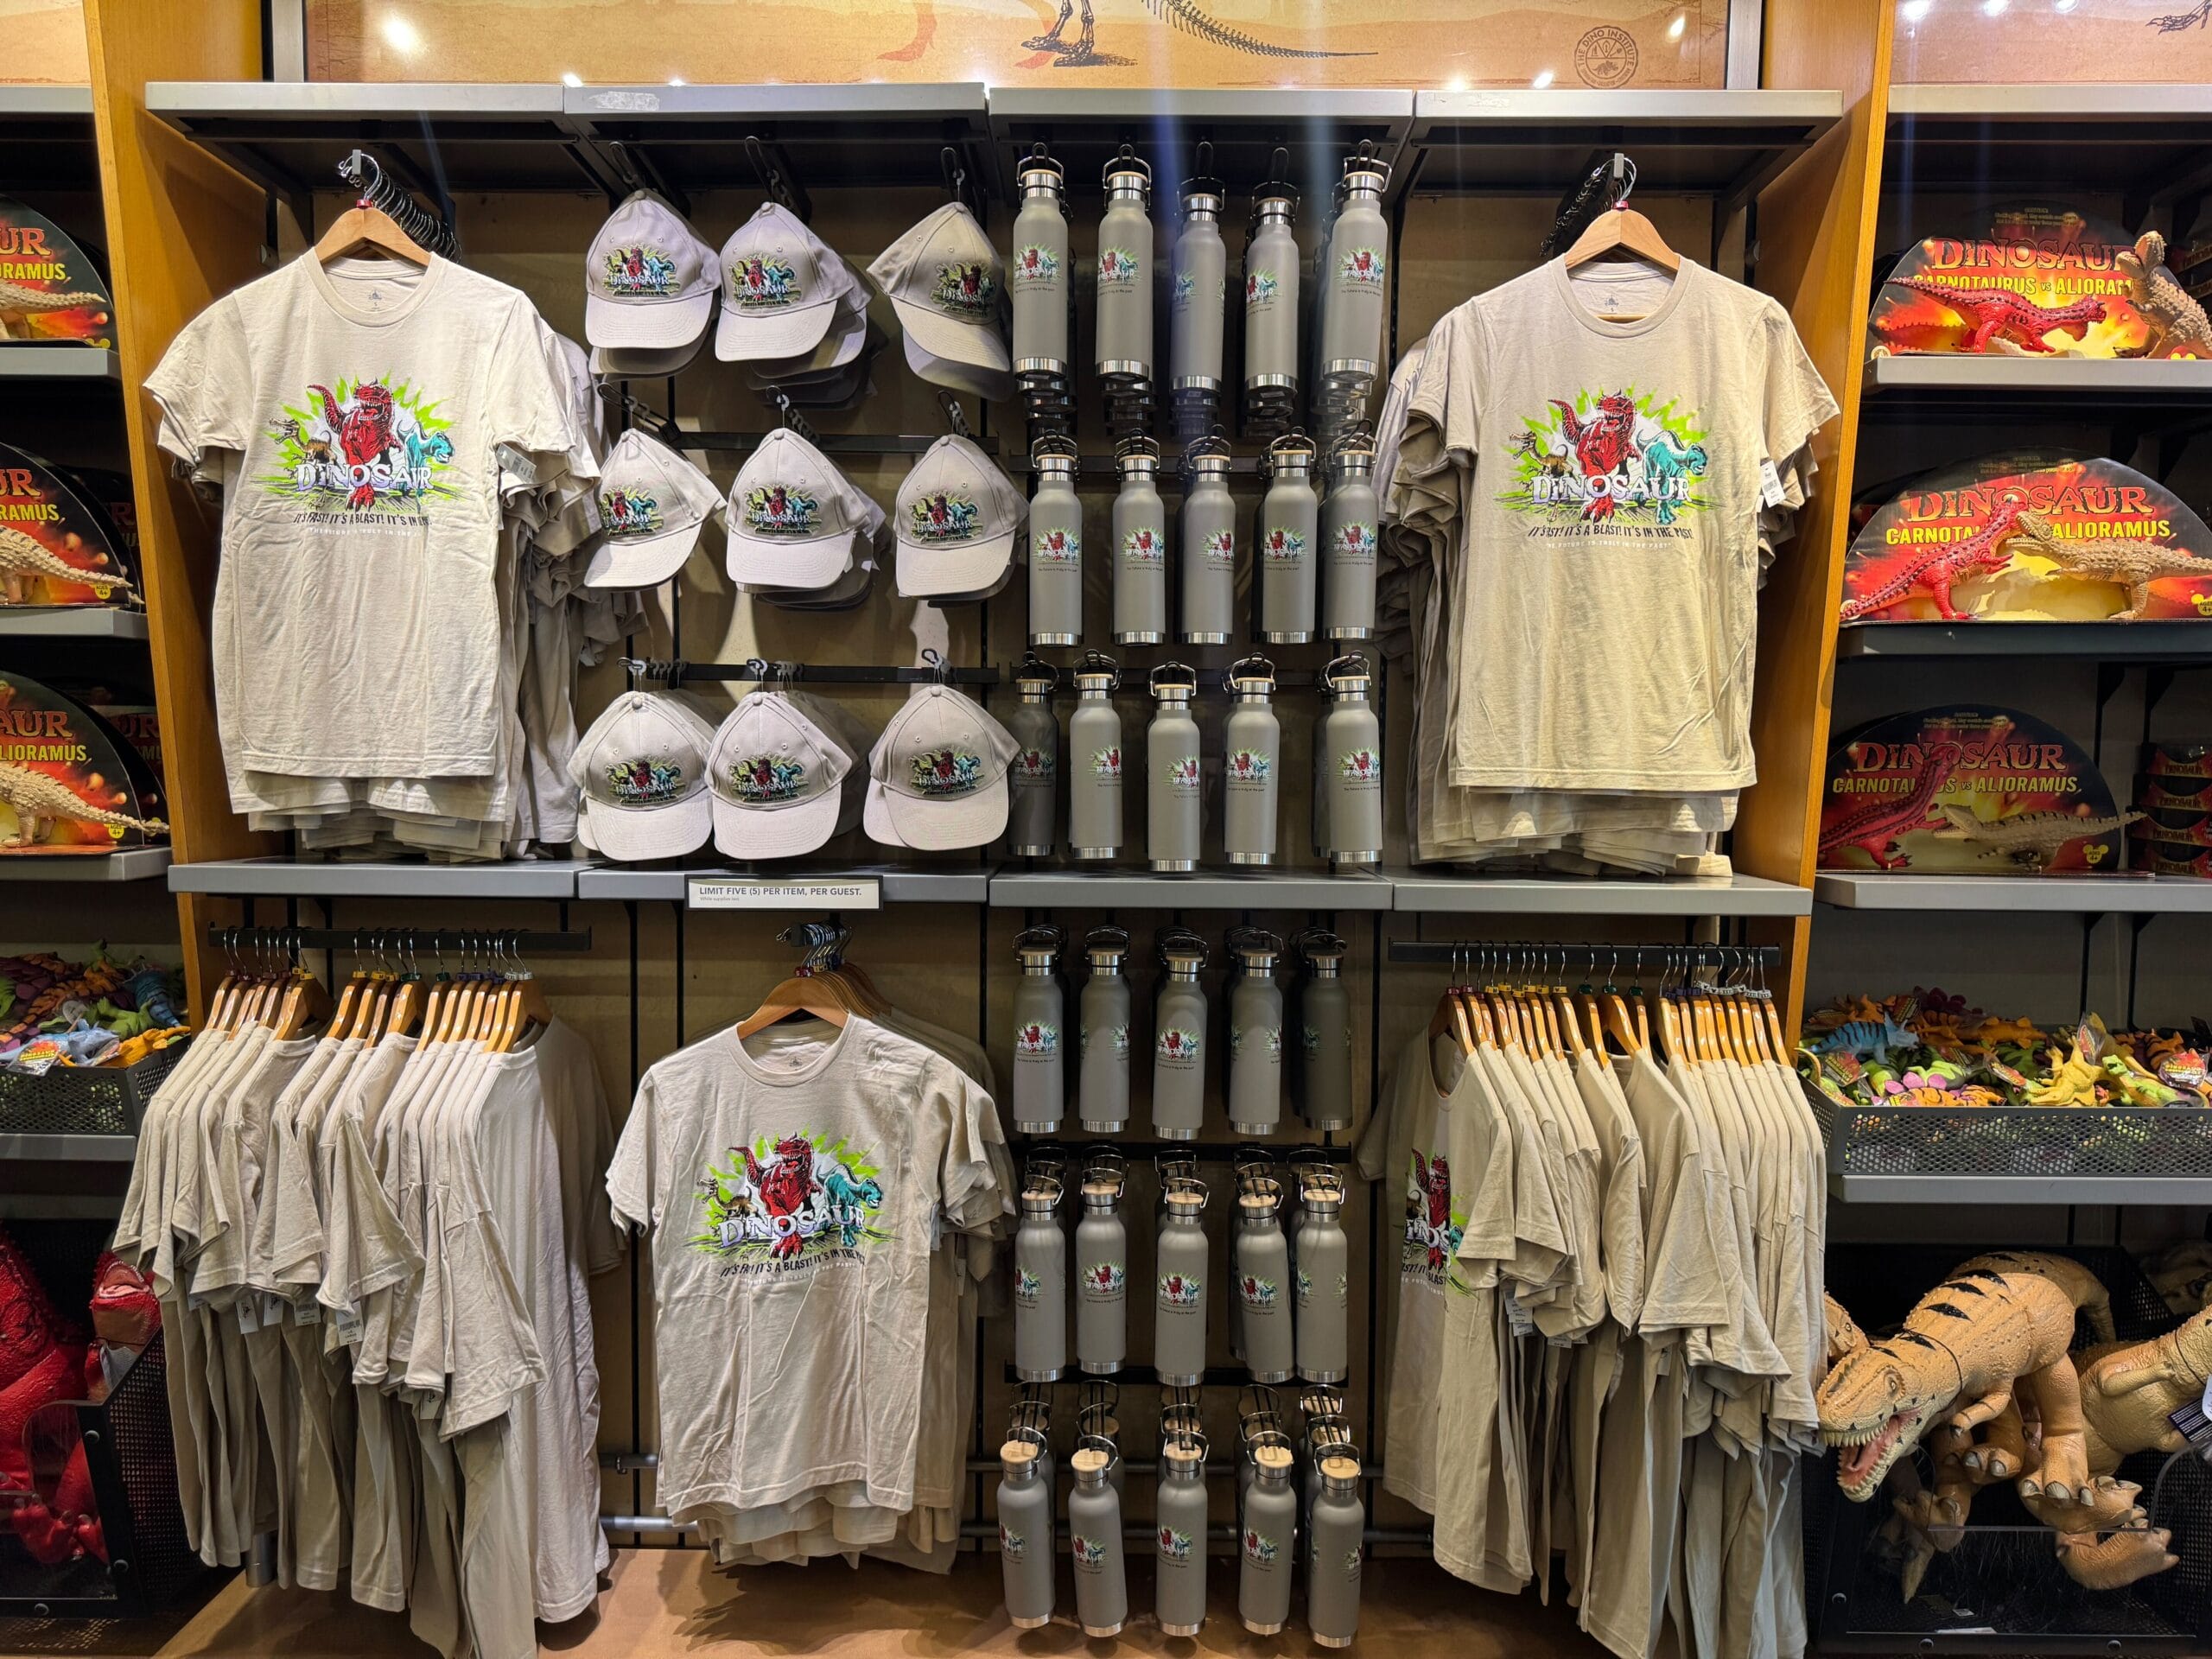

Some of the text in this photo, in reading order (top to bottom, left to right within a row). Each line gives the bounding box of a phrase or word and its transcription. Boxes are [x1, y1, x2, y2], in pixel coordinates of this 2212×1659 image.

[1582, 30, 1605, 48] DINO
[1607, 30, 1636, 67] INSTITUTE
[0, 263, 67, 280] RAMUS
[609, 272, 670, 287] DINOSAUR
[2055, 277, 2134, 296] ALIORAM
[1531, 474, 1693, 505] DINOSAUR
[0, 504, 60, 521] RAMUS
[1907, 485, 2156, 523] DINOSAUR
[330, 512, 346, 524] IT'S
[349, 514, 354, 525] A
[355, 513, 385, 524] BLAST!
[387, 513, 407, 525] IT'S
[751, 512, 810, 525] DINOSAUR
[916, 518, 974, 533] DINOSAUR
[1564, 524, 1581, 537] IT'S
[1583, 525, 1590, 536] A
[1593, 524, 1622, 536] BLAST!
[1624, 525, 1641, 537] IT'S
[1643, 527, 1654, 537] IN
[1654, 527, 1674, 538] THE
[1885, 519, 2171, 545] CARNOTA ALIORAMUS
[918, 770, 977, 785] DINOSAUR
[1975, 776, 2078, 794] ALIORAMUS
[615, 779, 677, 796] DINOSAUR
[700, 887, 723, 895] LIMIT
[749, 887, 760, 896] (5)
[783, 887, 808, 896] ITEM,
[810, 887, 828, 896] PER
[830, 887, 862, 896] GUEST.
[720, 1264, 738, 1277] IT'S
[755, 1261, 772, 1274] IT'S
[774, 1262, 781, 1273] A
[783, 1256, 813, 1270] BLAST!
[814, 1251, 830, 1263] IT'S
[830, 1249, 840, 1259] IN
[840, 1248, 855, 1259] THE
